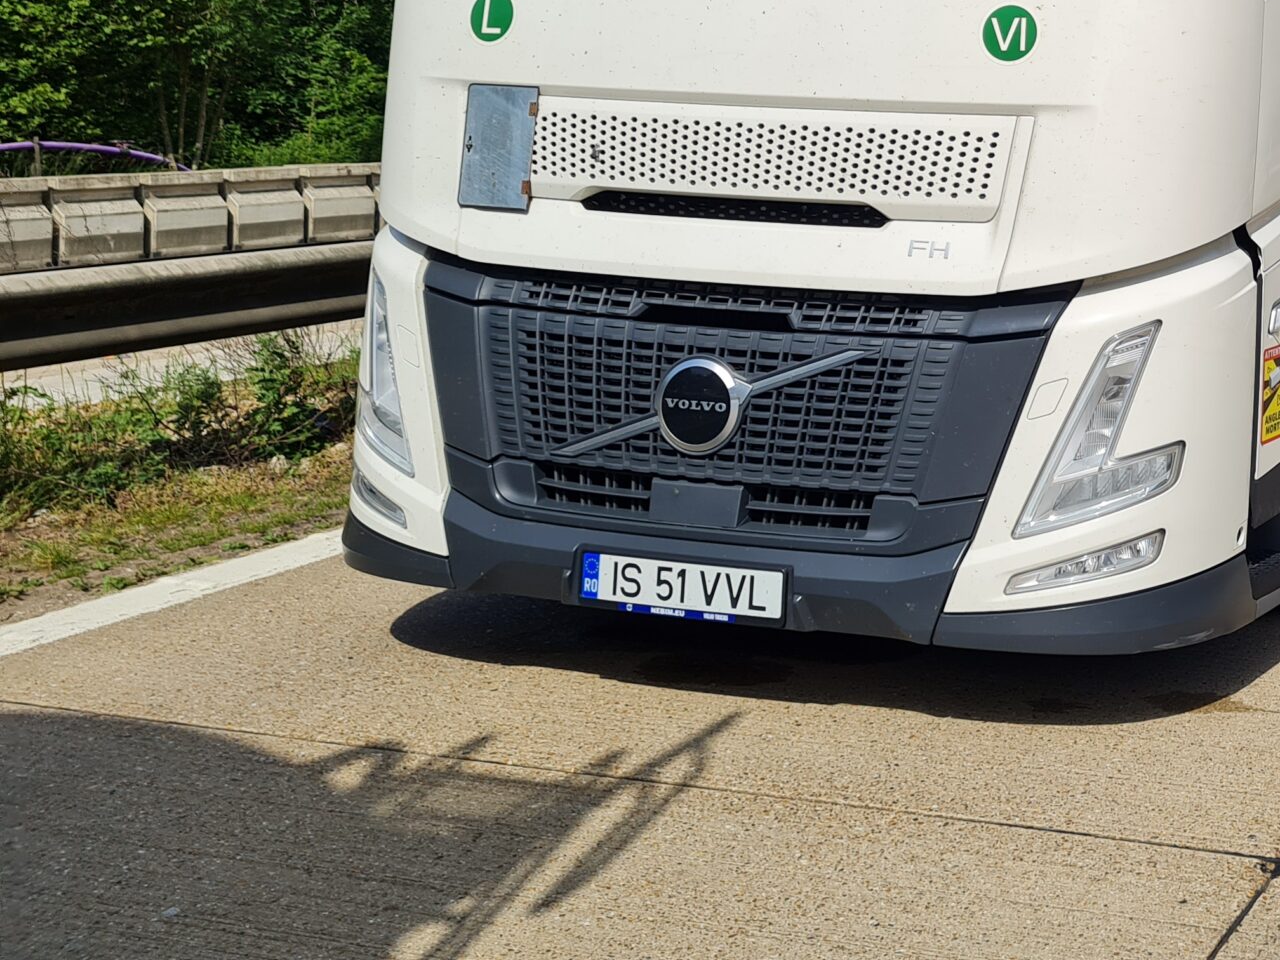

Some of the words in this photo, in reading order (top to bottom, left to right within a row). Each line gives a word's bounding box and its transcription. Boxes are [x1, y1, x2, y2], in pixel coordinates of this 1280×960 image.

[991, 17, 1027, 51] VI
[908, 240, 950, 259] FH
[664, 398, 727, 412] VOLVO
[583, 578, 598, 593] RO
[612, 561, 642, 598] IS
[656, 566, 687, 603] 51
[700, 570, 767, 612] VVL
